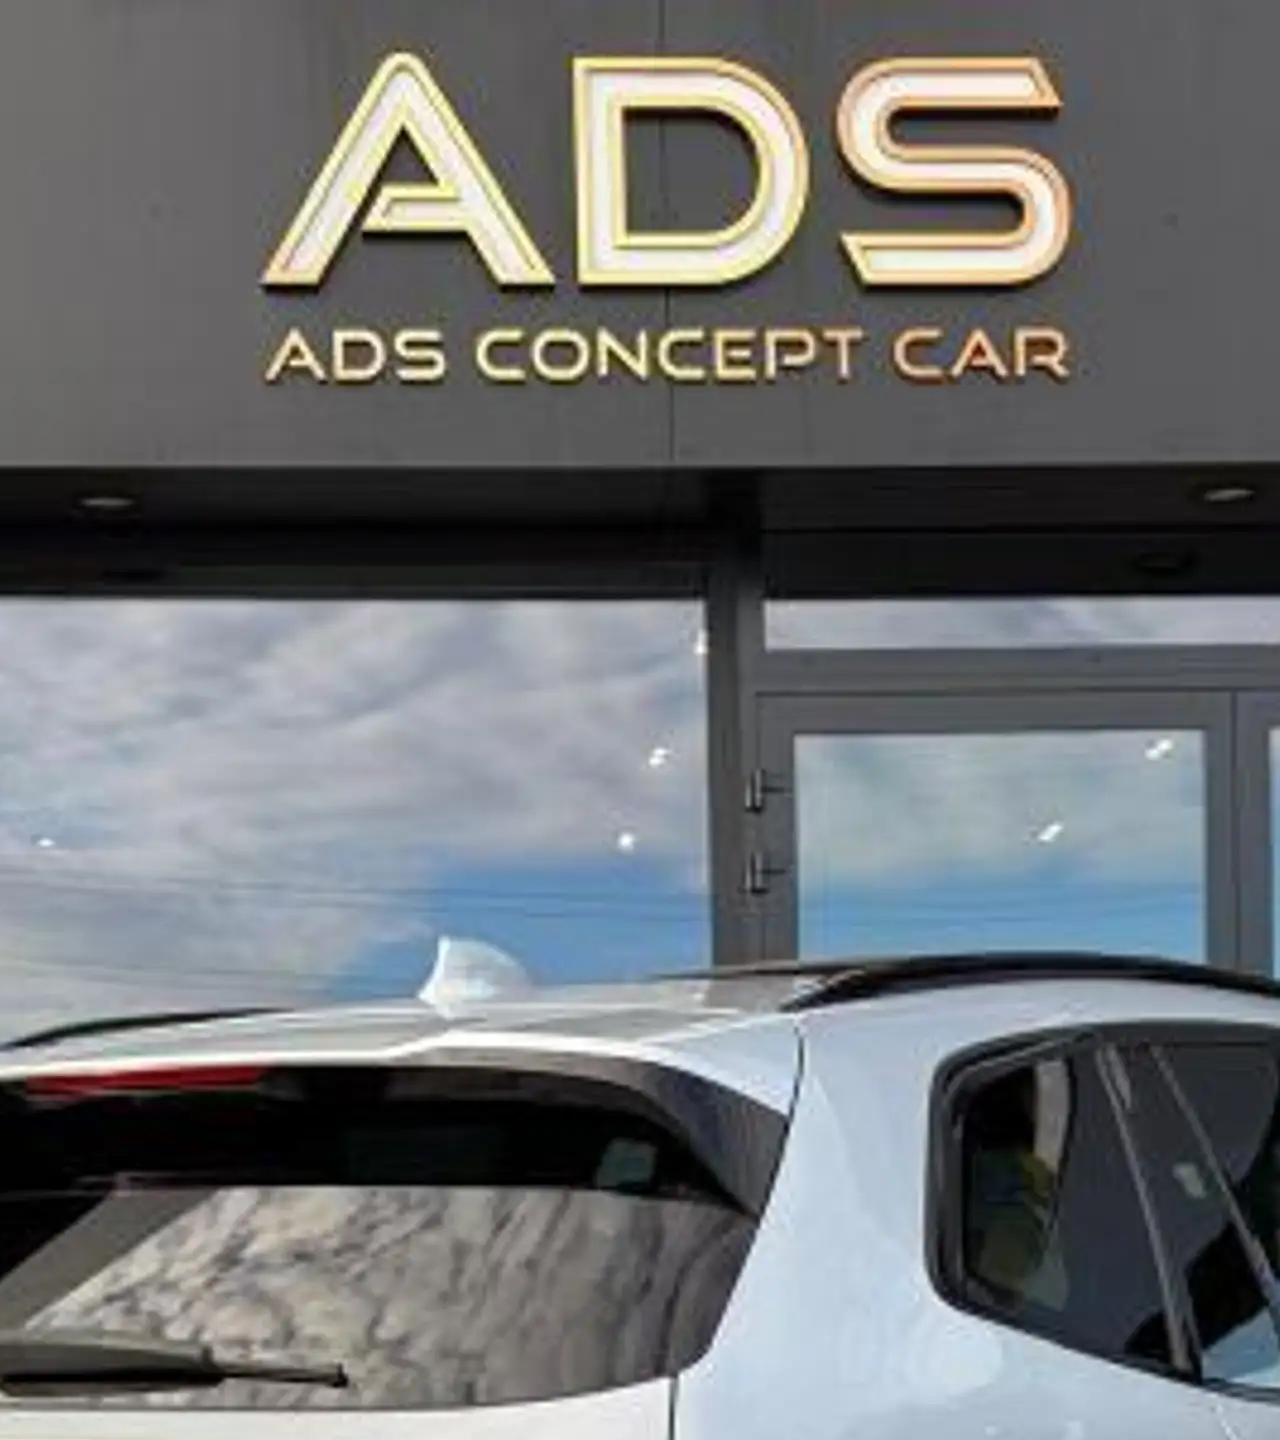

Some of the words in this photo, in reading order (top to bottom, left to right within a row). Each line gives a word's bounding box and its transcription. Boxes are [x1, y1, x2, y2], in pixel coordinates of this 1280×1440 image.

[261, 52, 1074, 287] ADS
[265, 328, 447, 381] ADS
[476, 328, 863, 381] CONCEPT
[893, 328, 1071, 381] CAR
